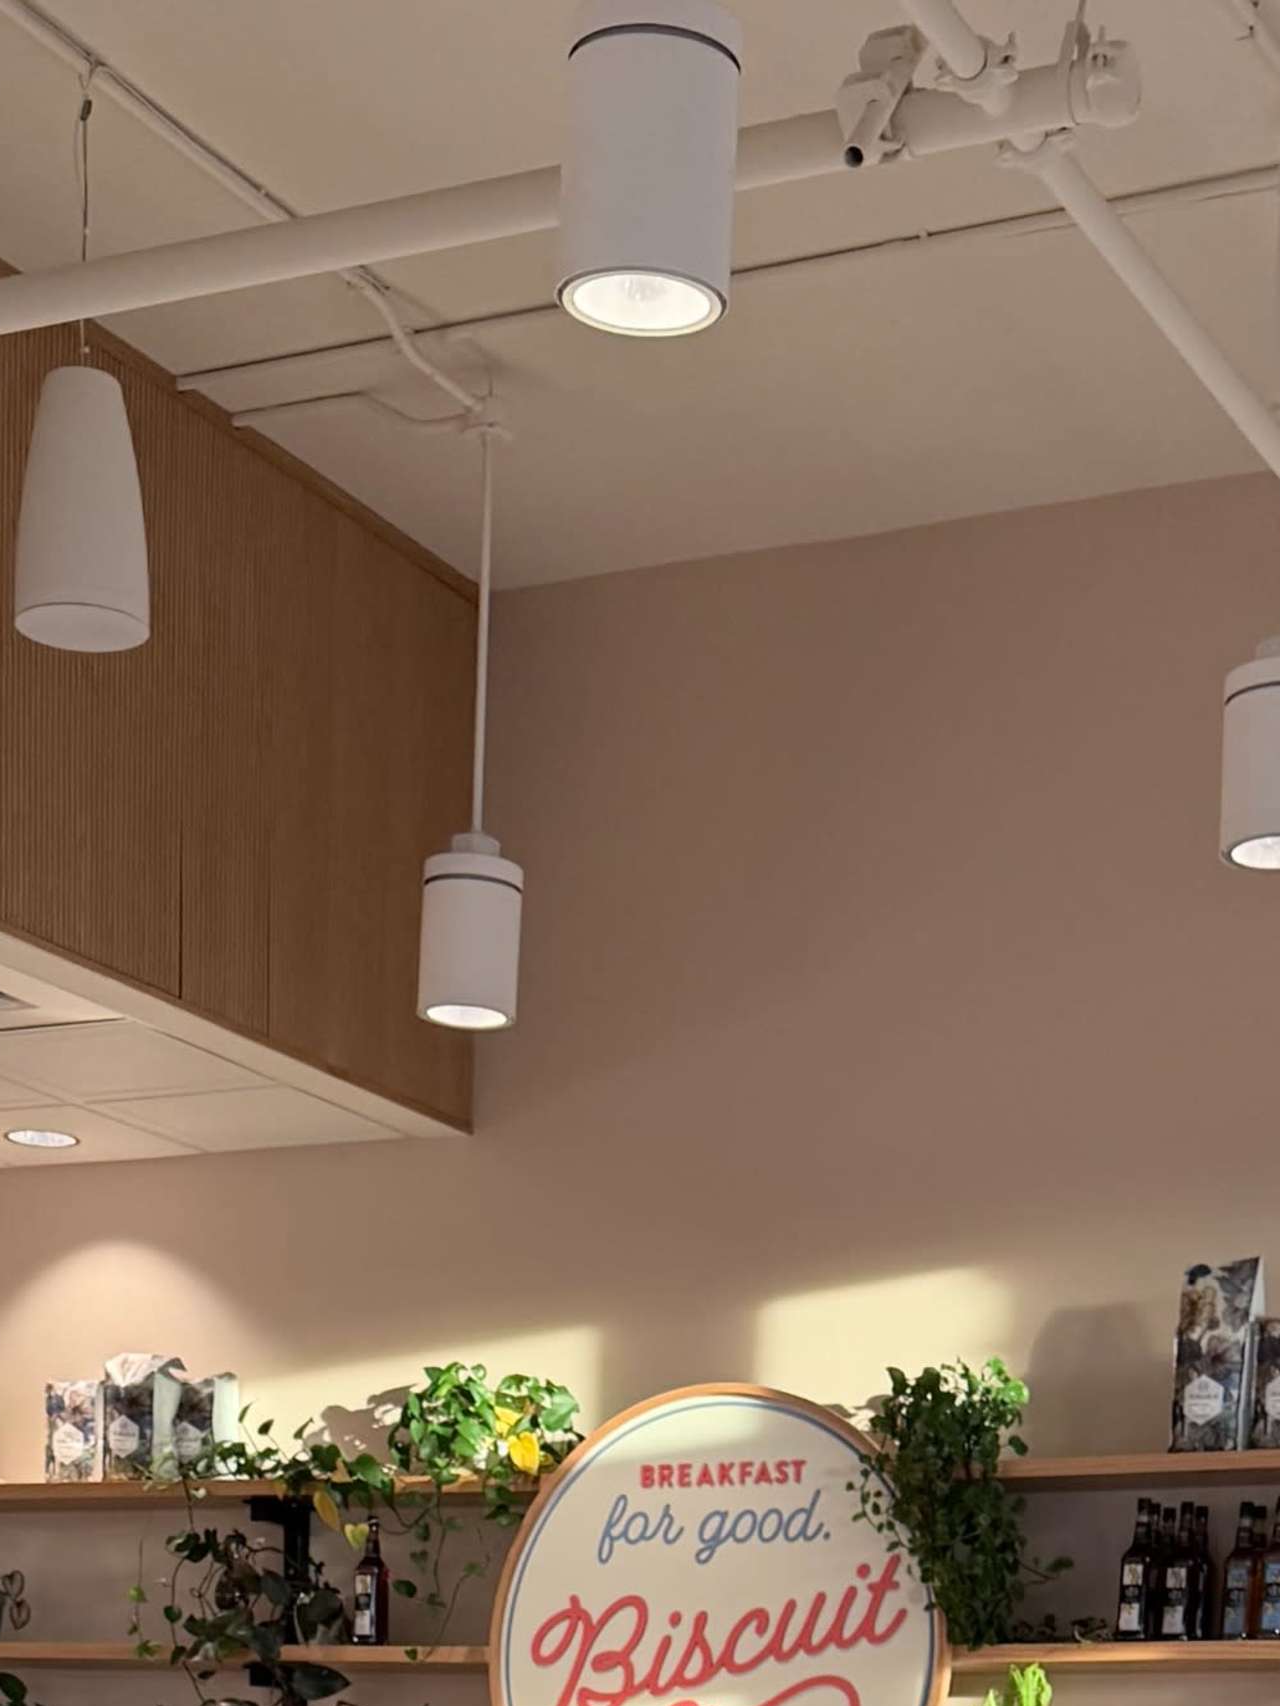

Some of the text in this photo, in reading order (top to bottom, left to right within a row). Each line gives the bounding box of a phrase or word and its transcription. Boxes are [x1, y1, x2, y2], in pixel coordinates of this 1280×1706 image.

[640, 1460, 807, 1488] BREAKFAST
[598, 1490, 832, 1565] for good.
